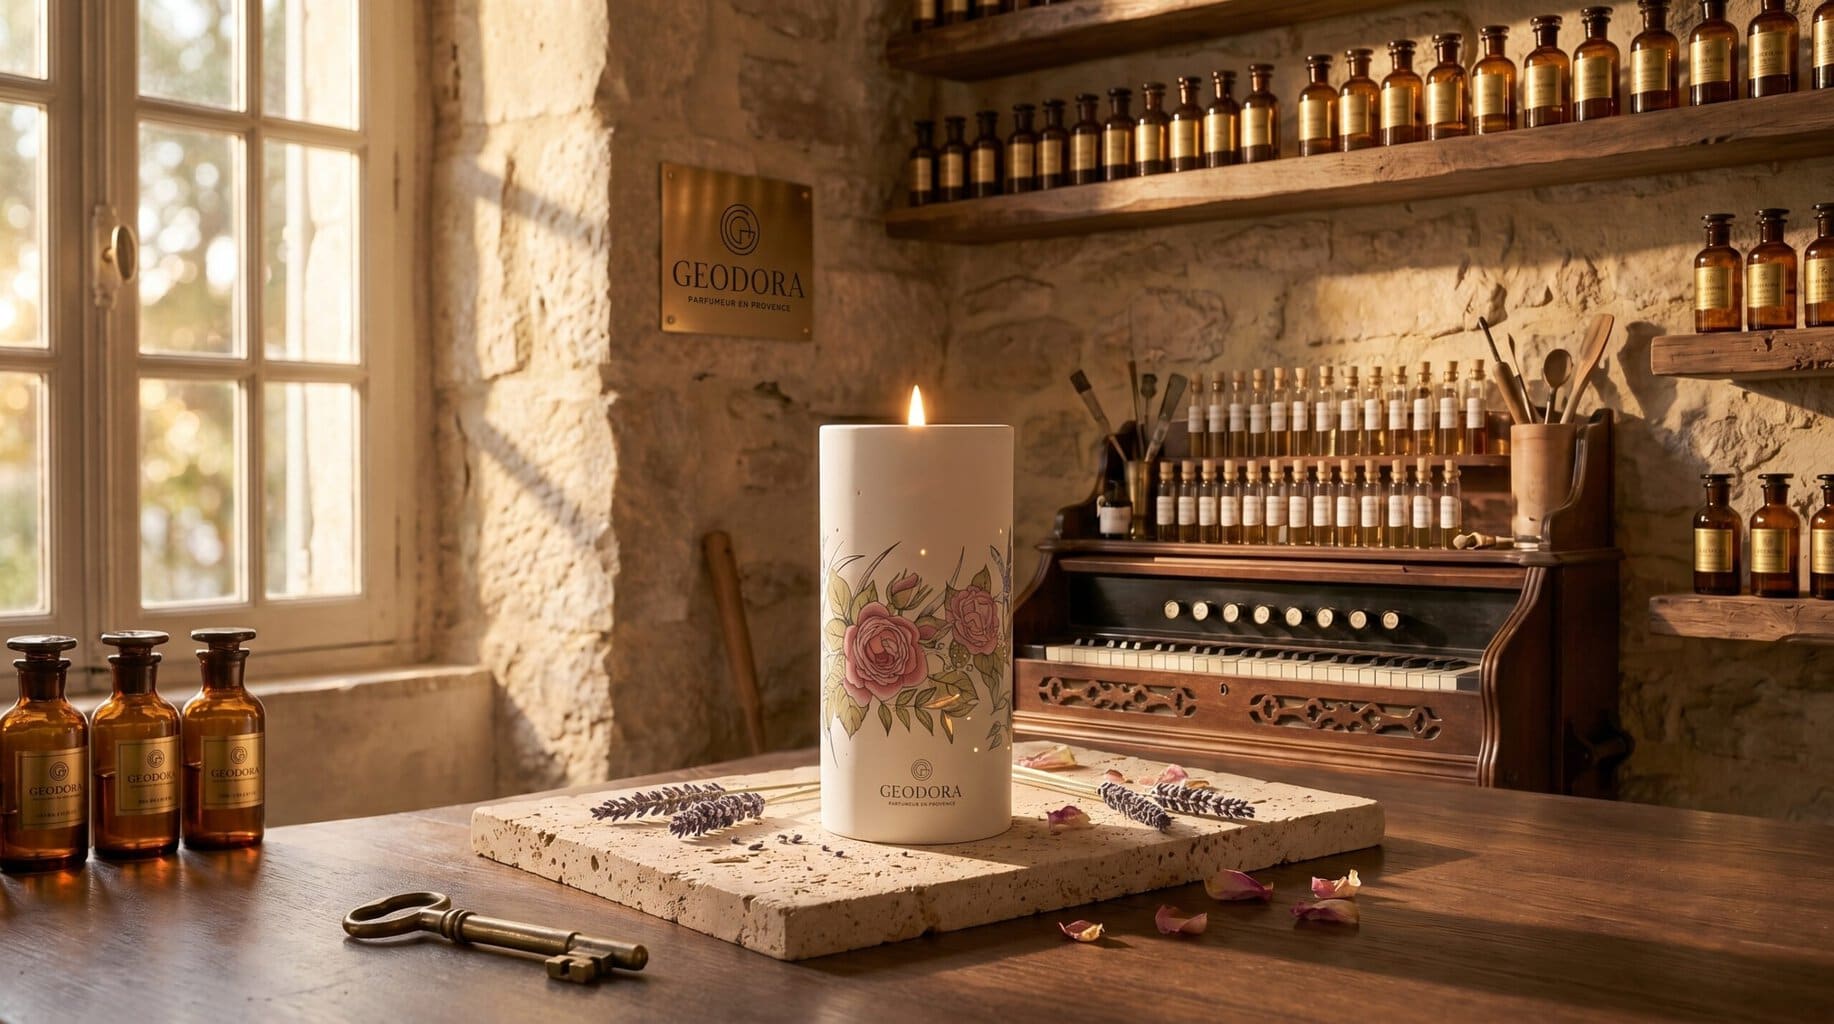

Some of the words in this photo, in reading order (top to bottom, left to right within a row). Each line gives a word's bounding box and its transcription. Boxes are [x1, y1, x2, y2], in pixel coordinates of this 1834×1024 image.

[672, 260, 805, 298] GEODORA
[688, 295, 736, 308] PARFUMEUR
[738, 300, 749, 309] EN
[751, 301, 792, 313] PROVENCE
[29, 783, 82, 796] GEODORA
[880, 784, 962, 799] GEODORA
